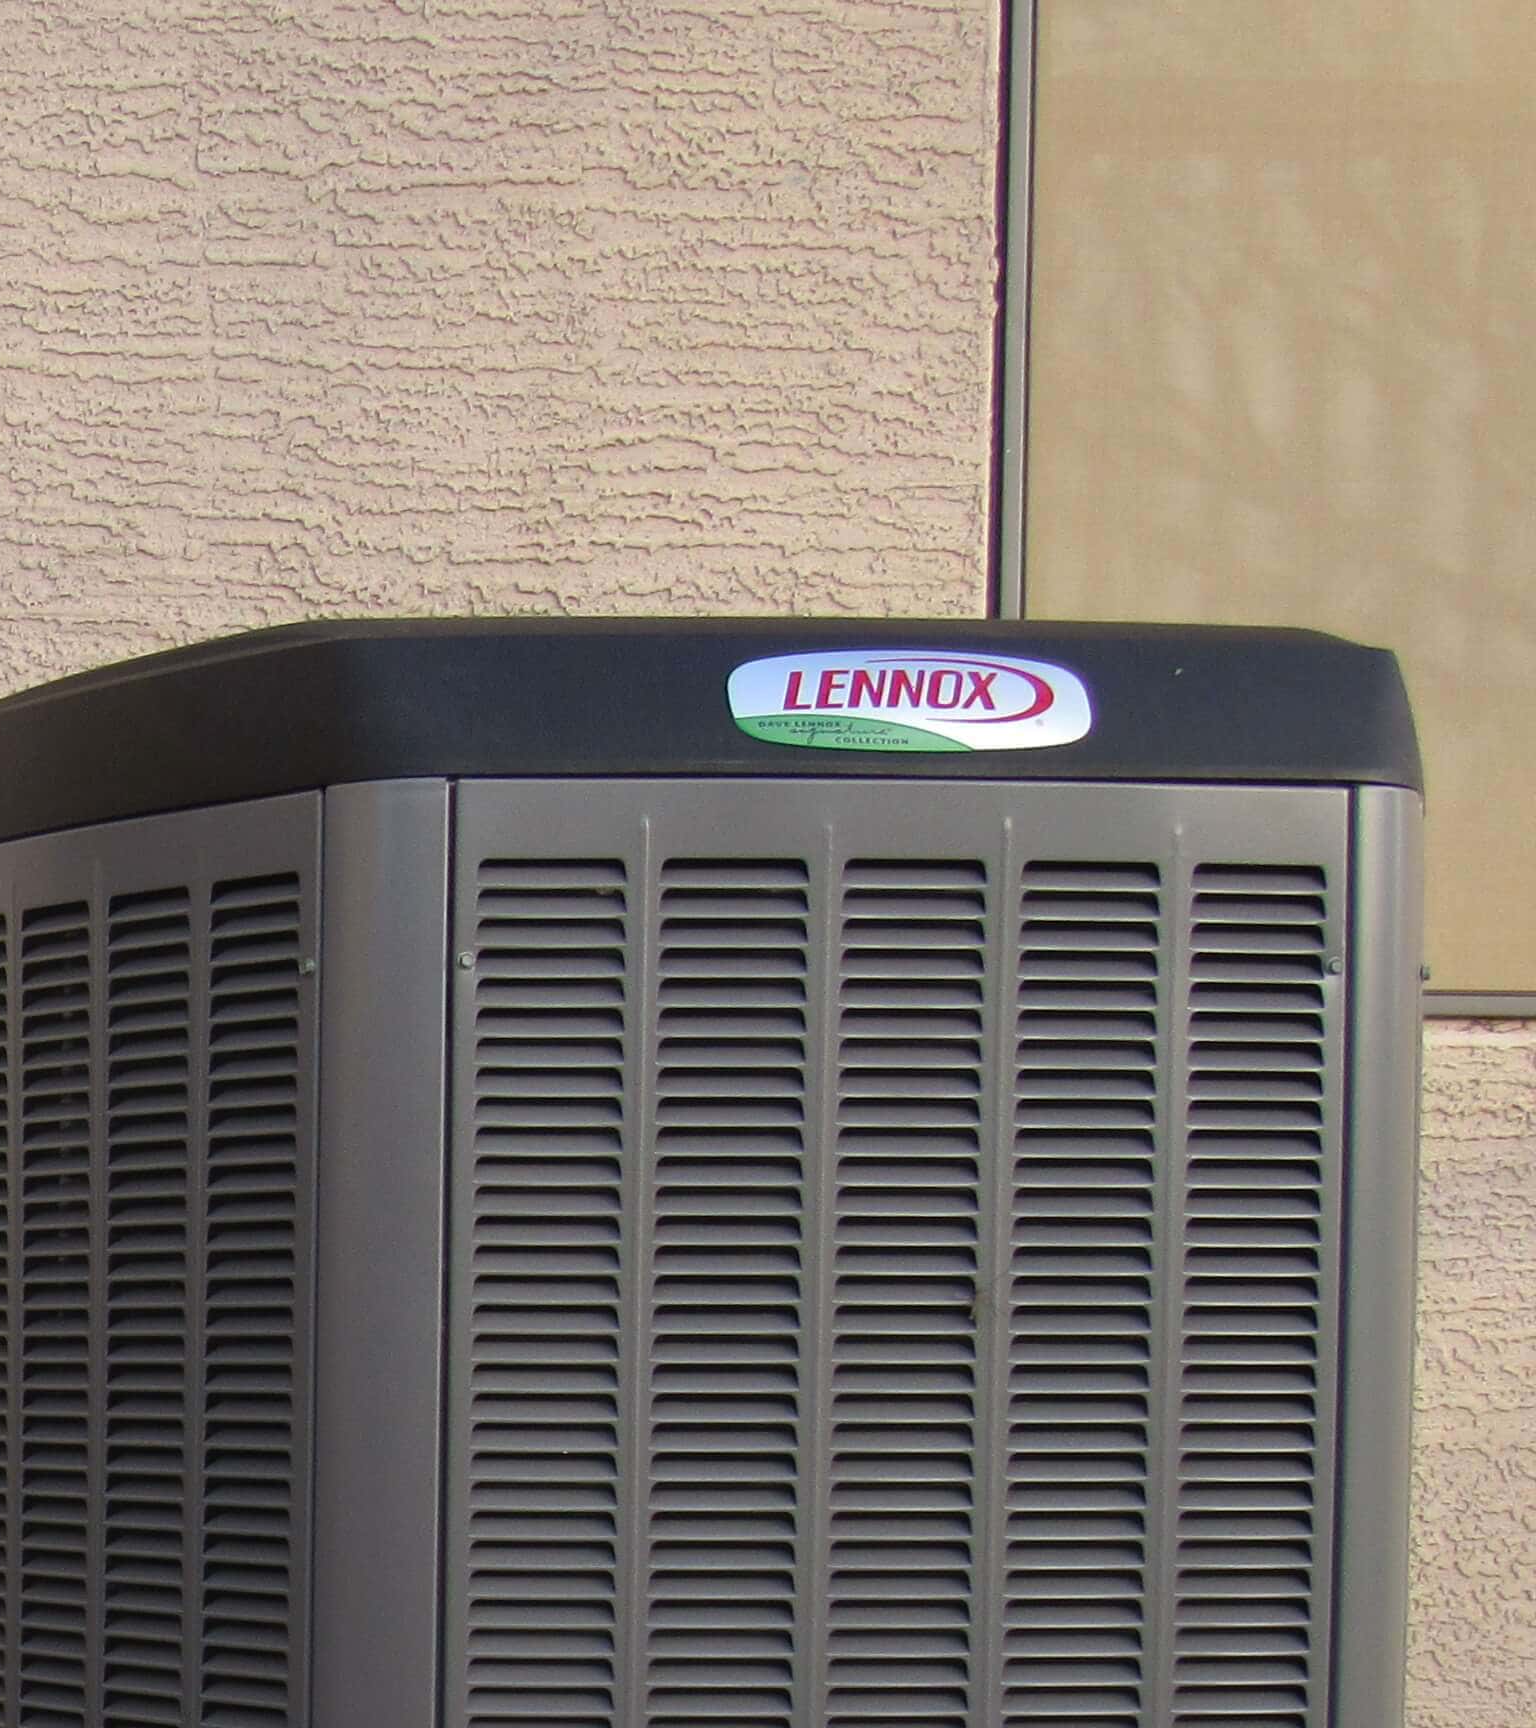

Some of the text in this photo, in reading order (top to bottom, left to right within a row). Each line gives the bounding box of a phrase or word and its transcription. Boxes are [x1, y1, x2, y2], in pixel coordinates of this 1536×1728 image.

[783, 669, 997, 711] LENNOX
[758, 720, 841, 728] DAVE LENNOX
[834, 736, 909, 745] COLLECTION
